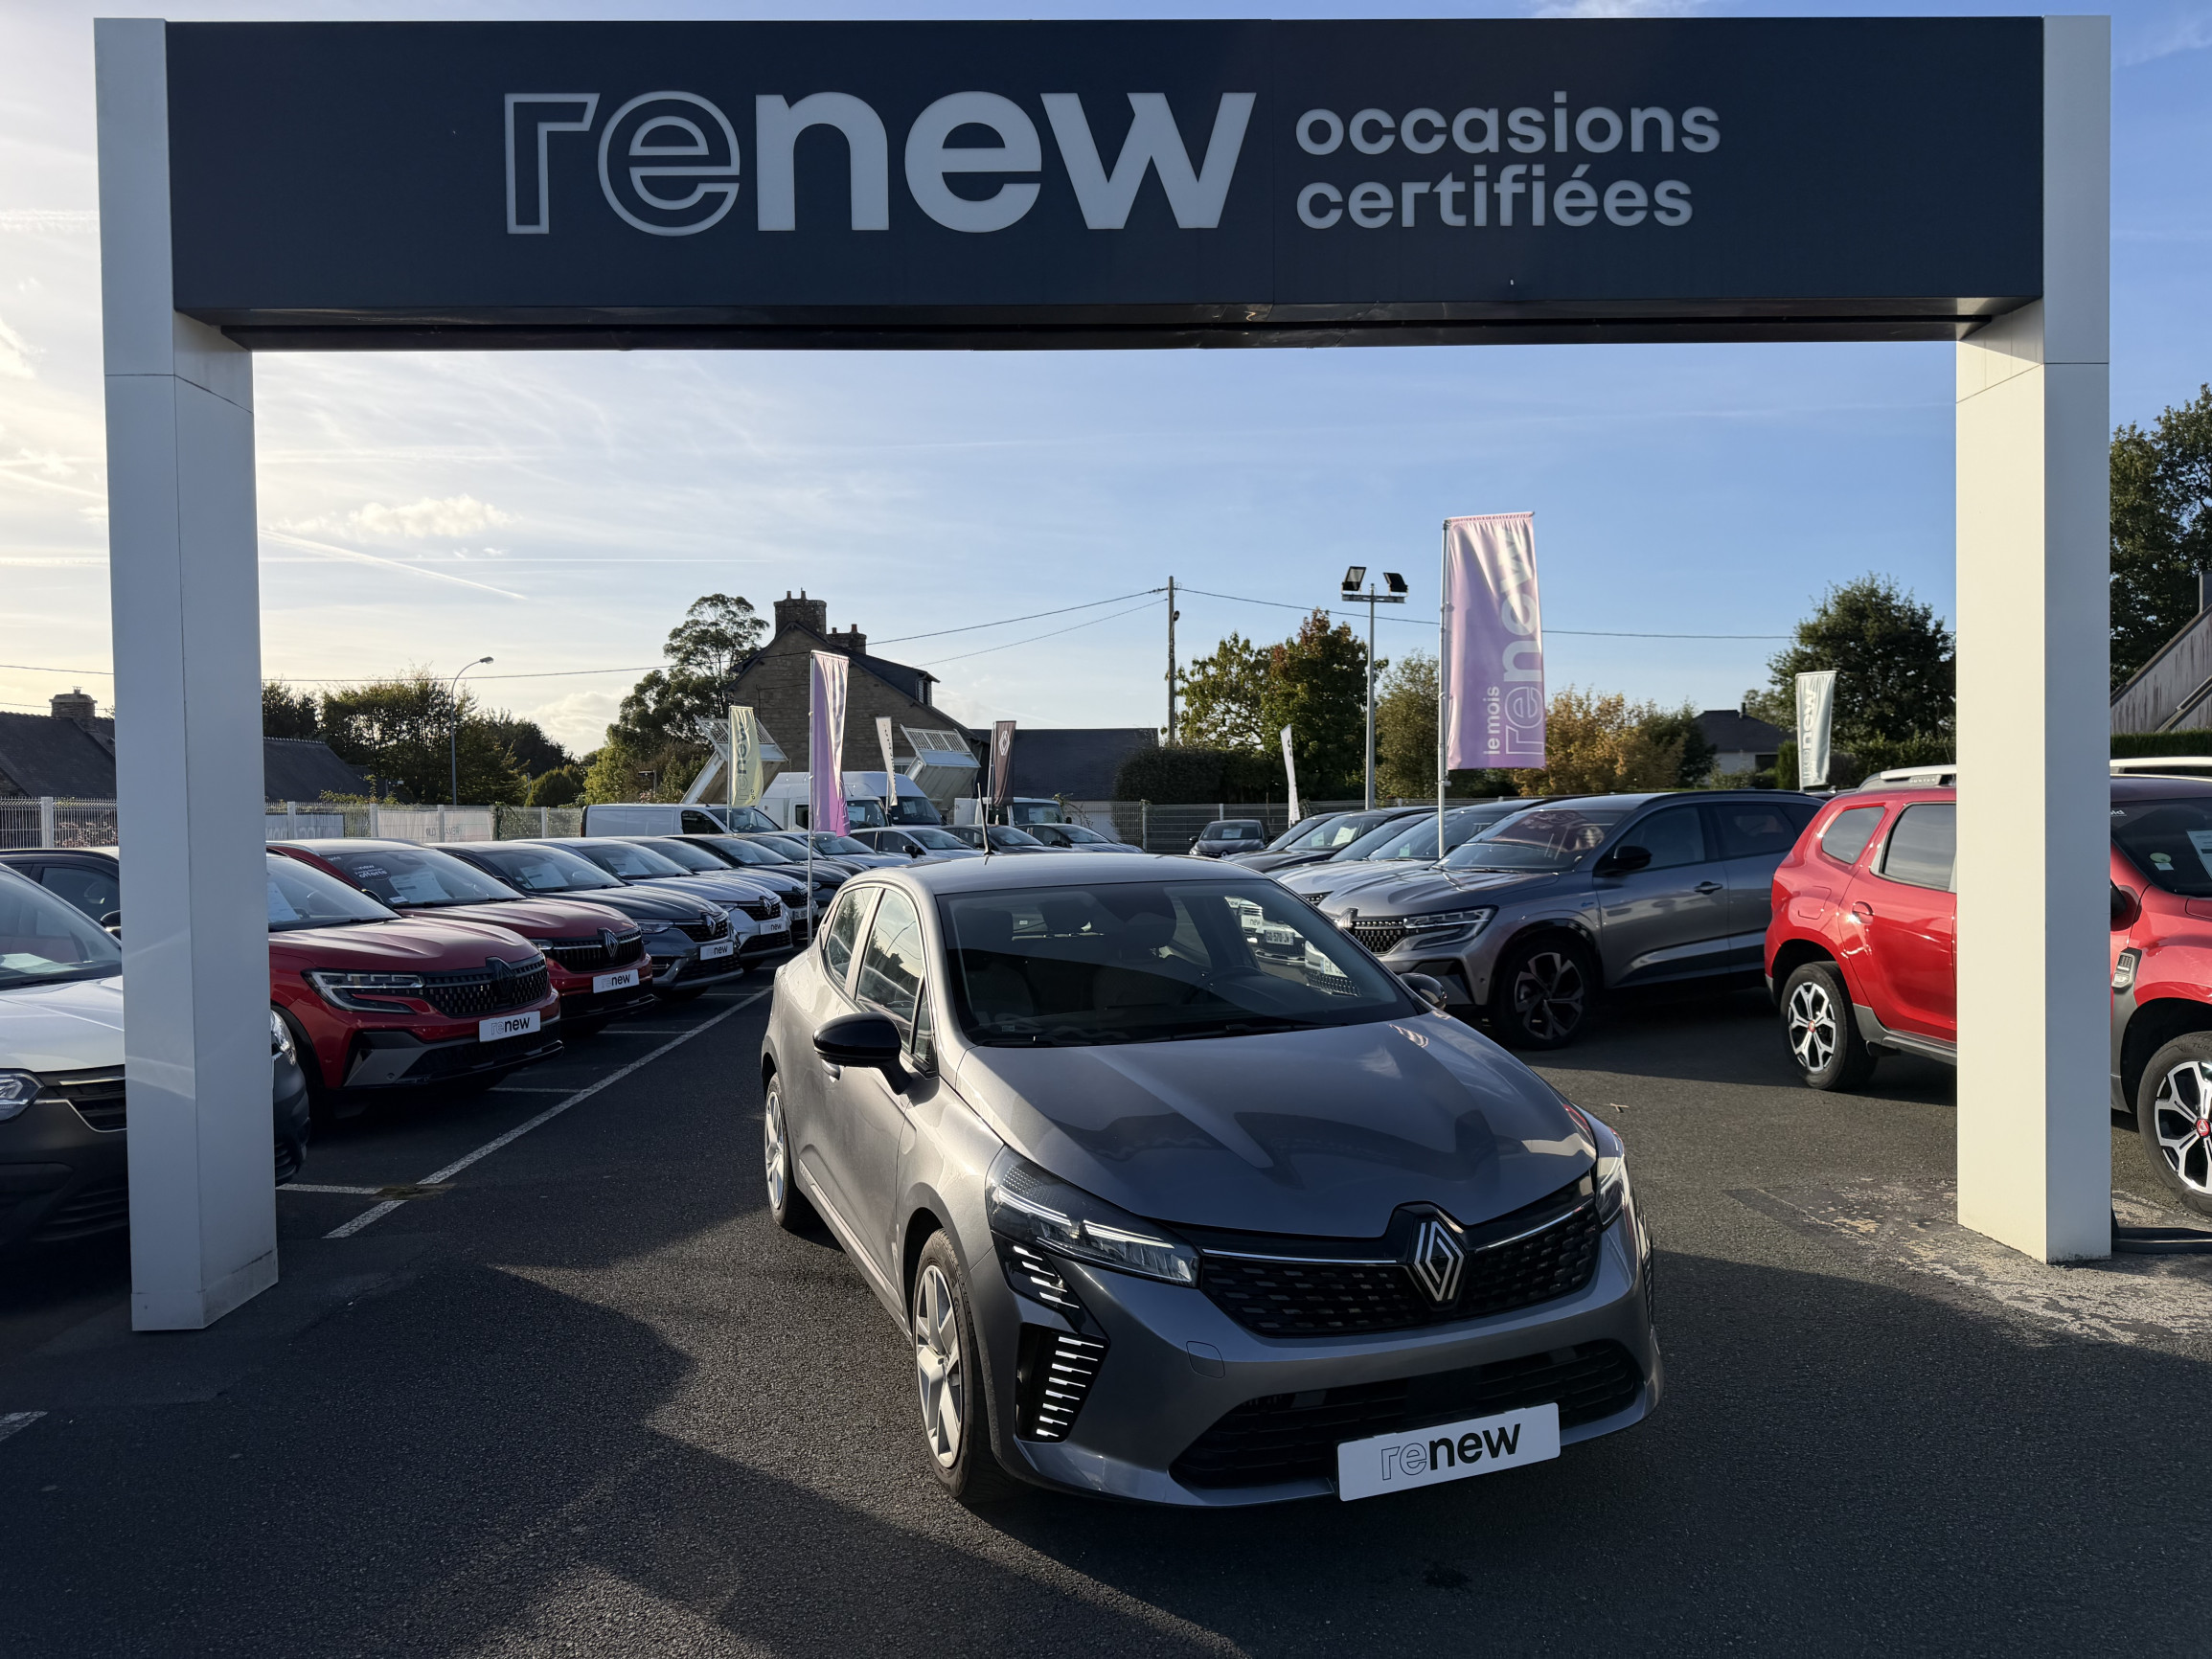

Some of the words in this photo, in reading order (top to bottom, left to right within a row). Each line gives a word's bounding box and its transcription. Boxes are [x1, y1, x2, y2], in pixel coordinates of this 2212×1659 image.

[1295, 91, 1722, 156] occasions
[504, 90, 1257, 237] renew
[1295, 163, 1694, 229] certifiées
[1496, 528, 1545, 755] renew
[1482, 686, 1501, 735] mois
[1483, 738, 1501, 755] le
[491, 1017, 530, 1035] renew
[1380, 1423, 1521, 1481] renew
